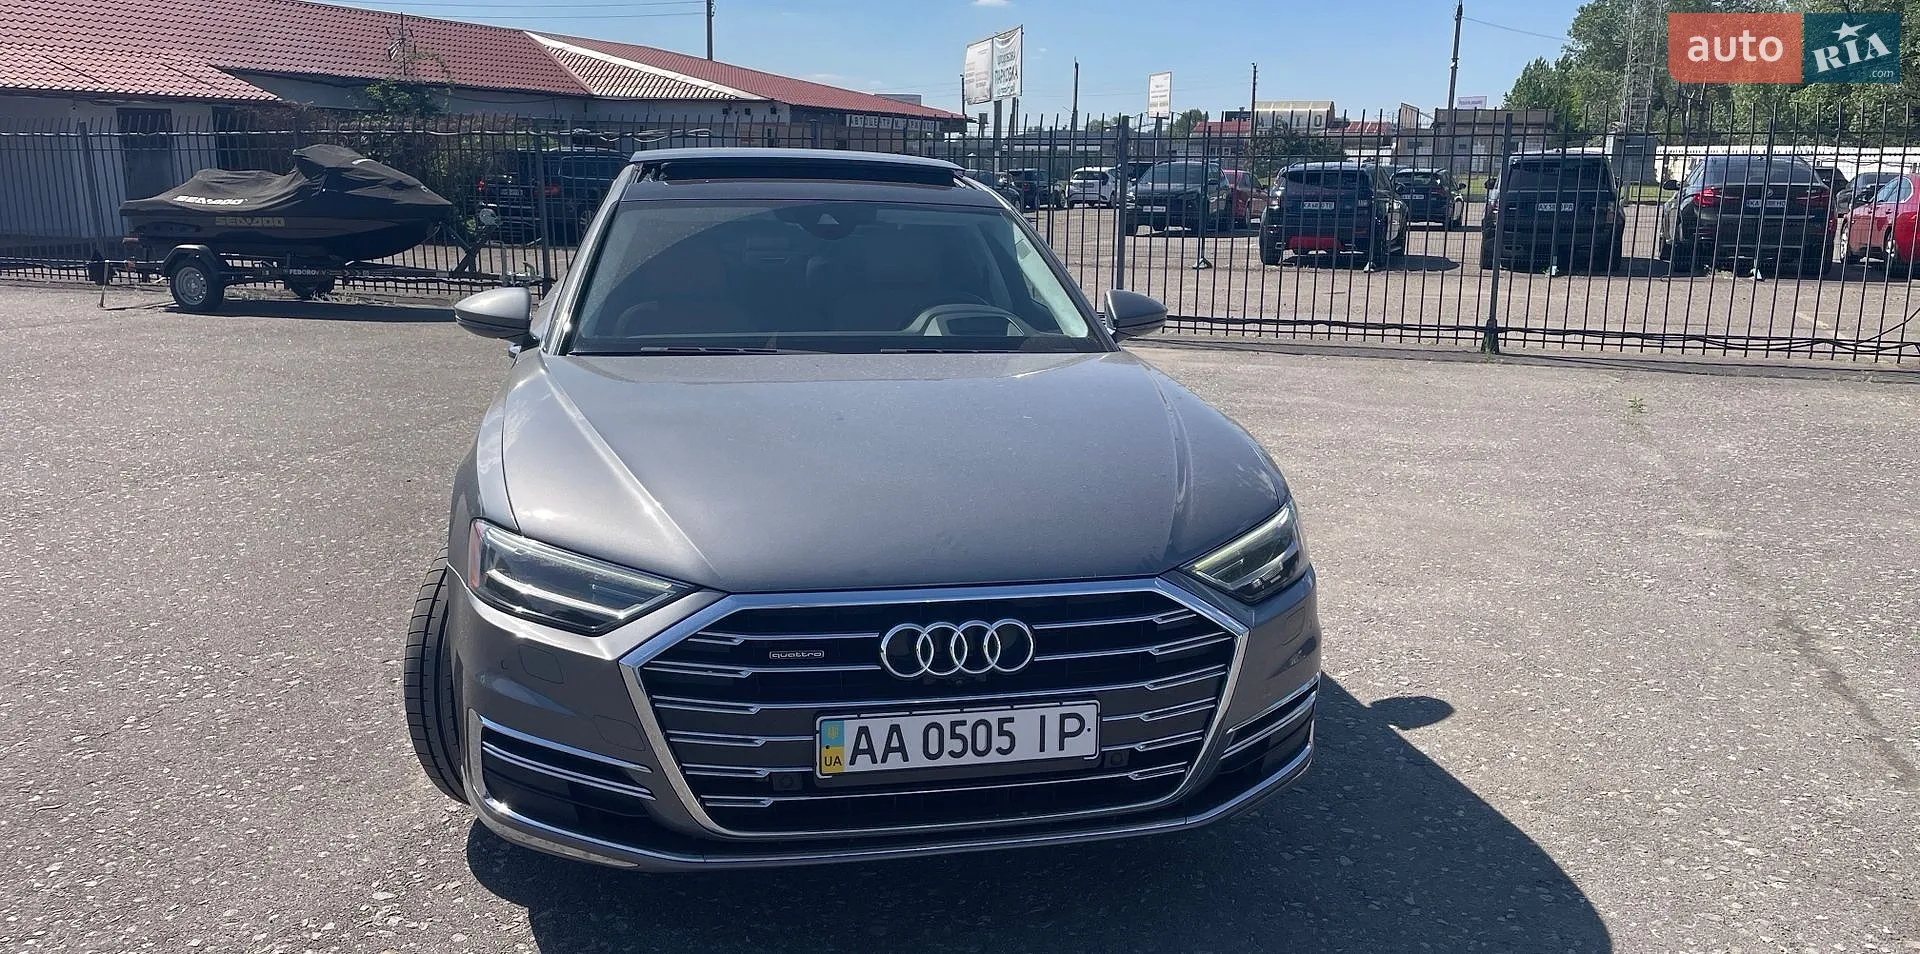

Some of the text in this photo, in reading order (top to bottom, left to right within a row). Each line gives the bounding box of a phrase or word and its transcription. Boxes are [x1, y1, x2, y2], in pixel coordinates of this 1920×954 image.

[771, 651, 822, 659] quattro
[849, 712, 1086, 766] AA 0505 IP
[824, 756, 842, 766] UA
